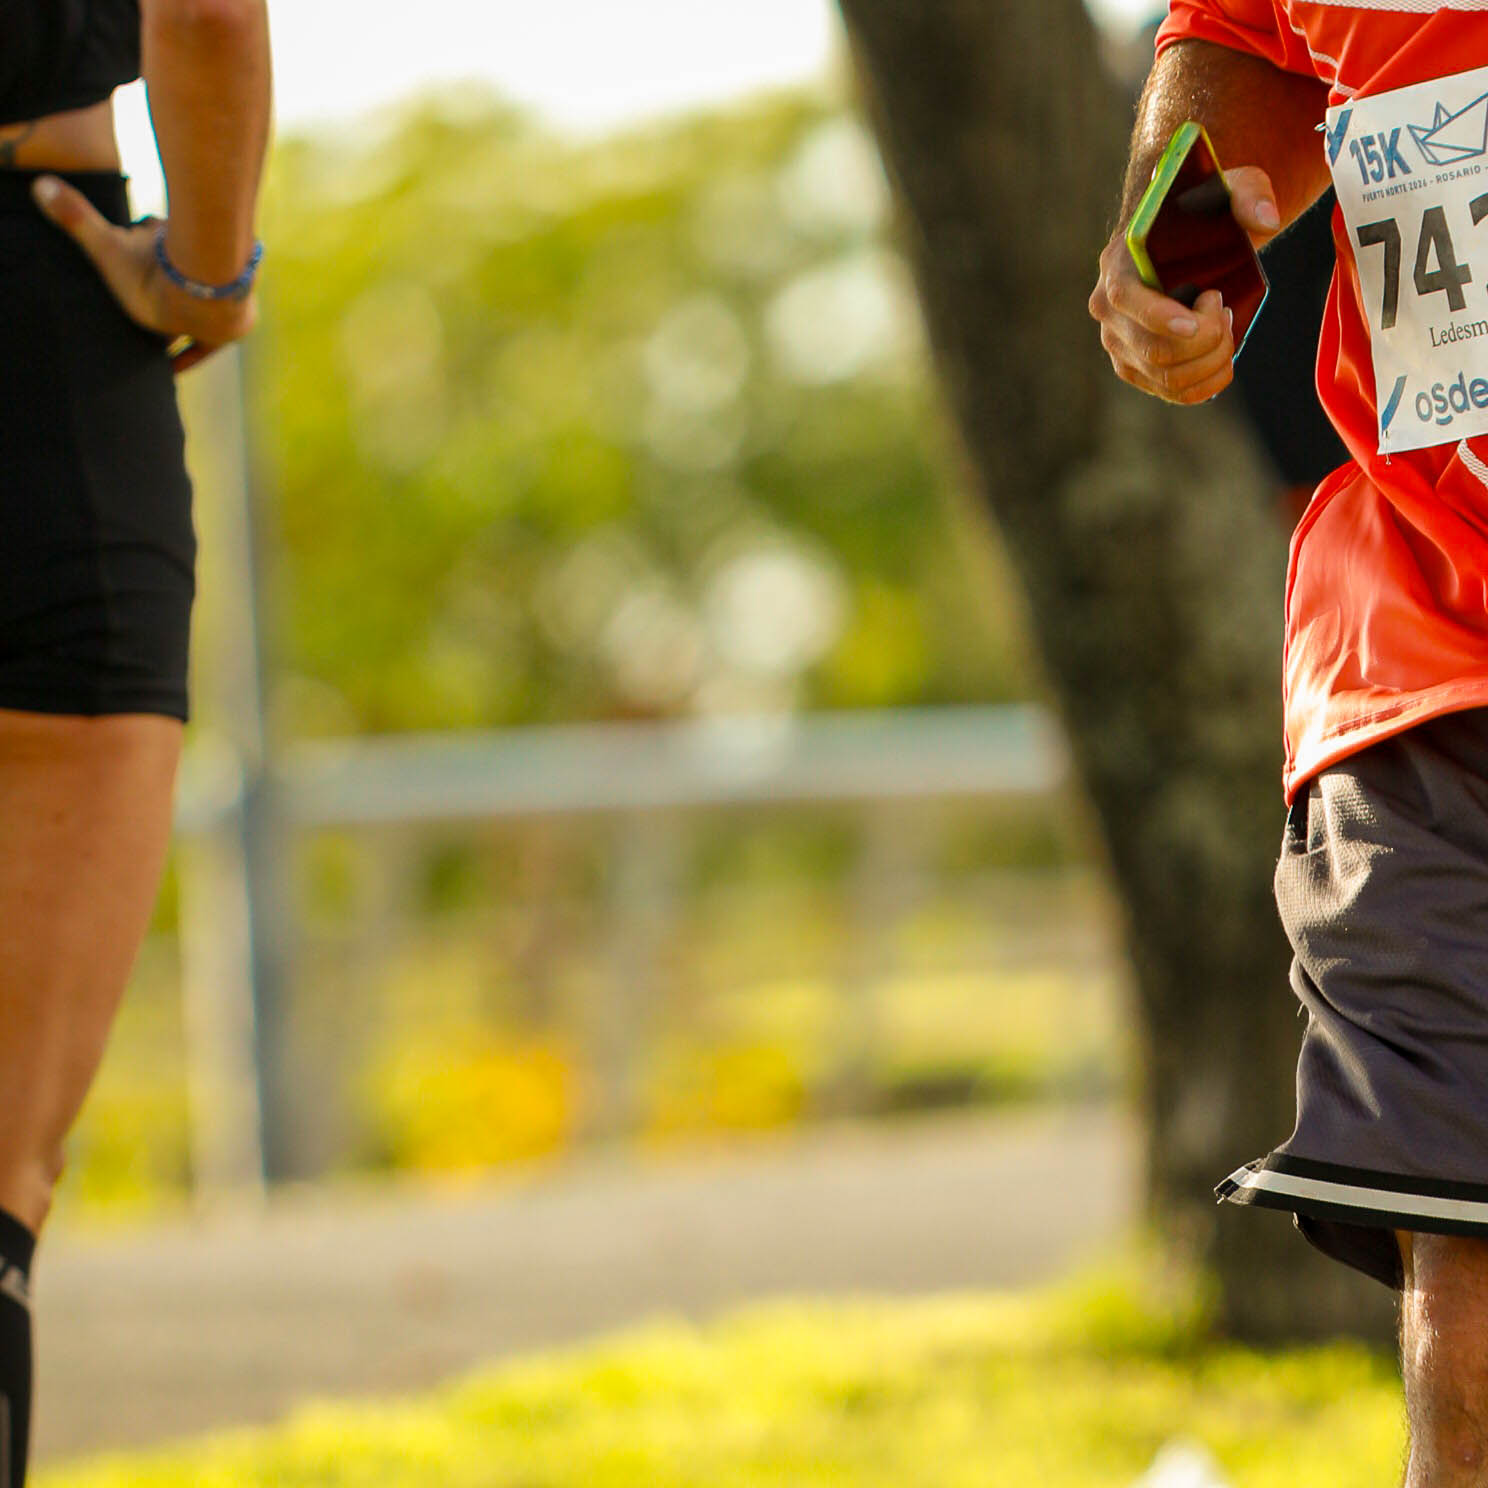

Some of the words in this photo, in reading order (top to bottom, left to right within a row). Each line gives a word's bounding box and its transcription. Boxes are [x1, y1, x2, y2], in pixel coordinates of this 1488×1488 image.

[1349, 127, 1412, 185] 15K
[1386, 182, 1407, 197] NORTE
[1435, 165, 1481, 184] ROSARIO
